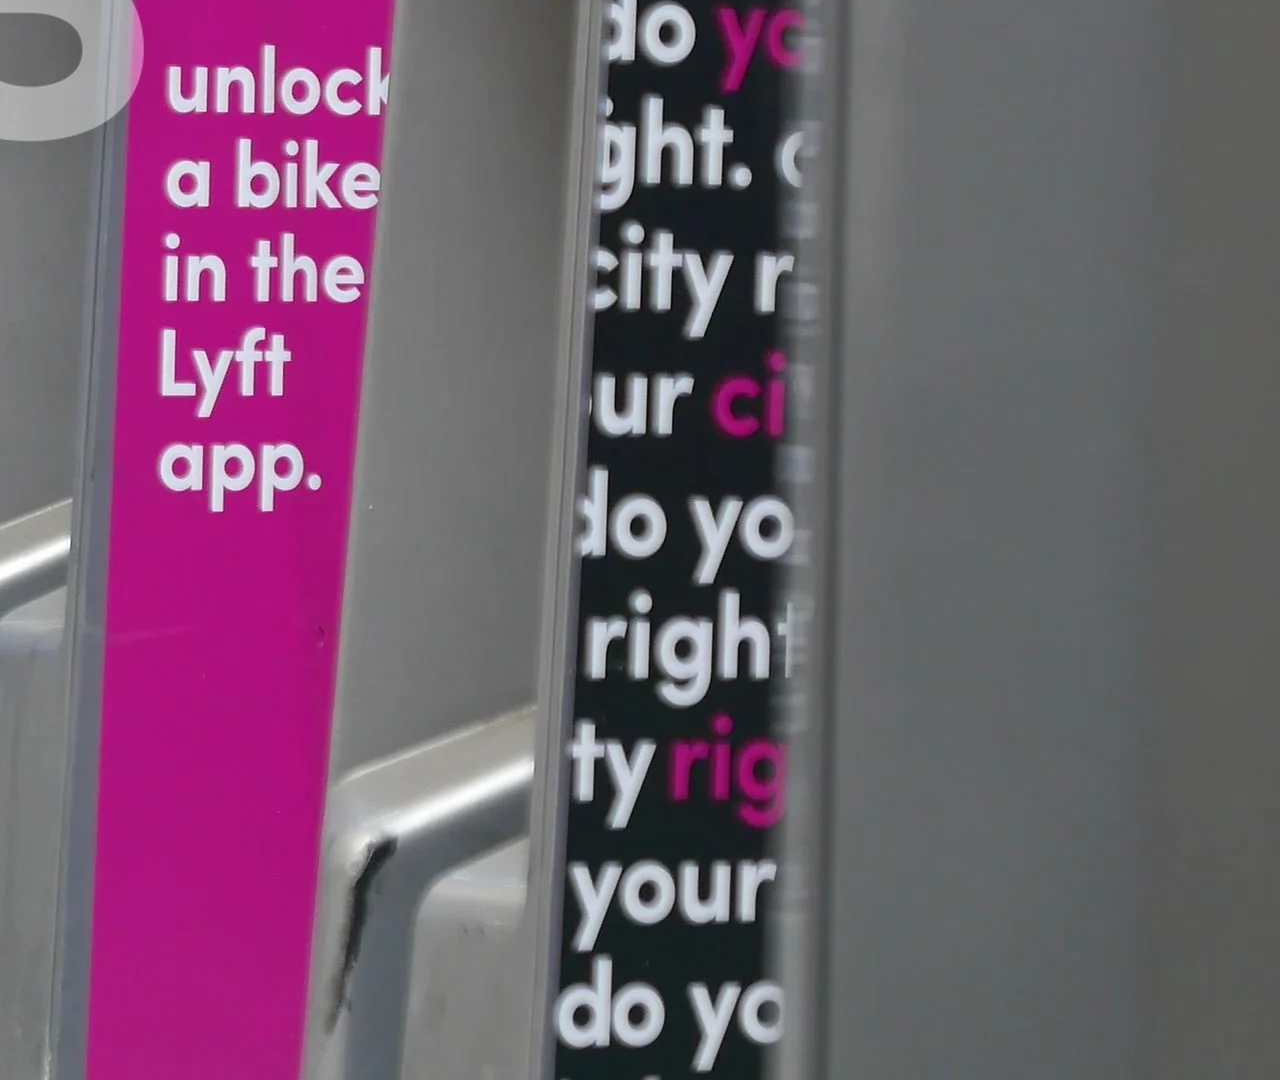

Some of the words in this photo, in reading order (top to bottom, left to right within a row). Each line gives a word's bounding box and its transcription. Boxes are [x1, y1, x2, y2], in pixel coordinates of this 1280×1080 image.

[166, 44, 390, 116] unlock
[165, 159, 211, 209] a
[236, 138, 381, 209] bike
[595, 94, 753, 212] ght.
[163, 232, 227, 302] in
[251, 232, 365, 303] the
[593, 222, 736, 339] city
[753, 251, 796, 313] r
[160, 327, 292, 419] Lyft
[589, 372, 694, 437] ur
[709, 349, 787, 438] ci
[159, 443, 323, 513] app.
[579, 465, 668, 559] do
[687, 496, 795, 585] yo
[568, 719, 657, 830] ty
[667, 712, 789, 830] rig
[567, 860, 778, 952] your
[555, 954, 666, 1049] do
